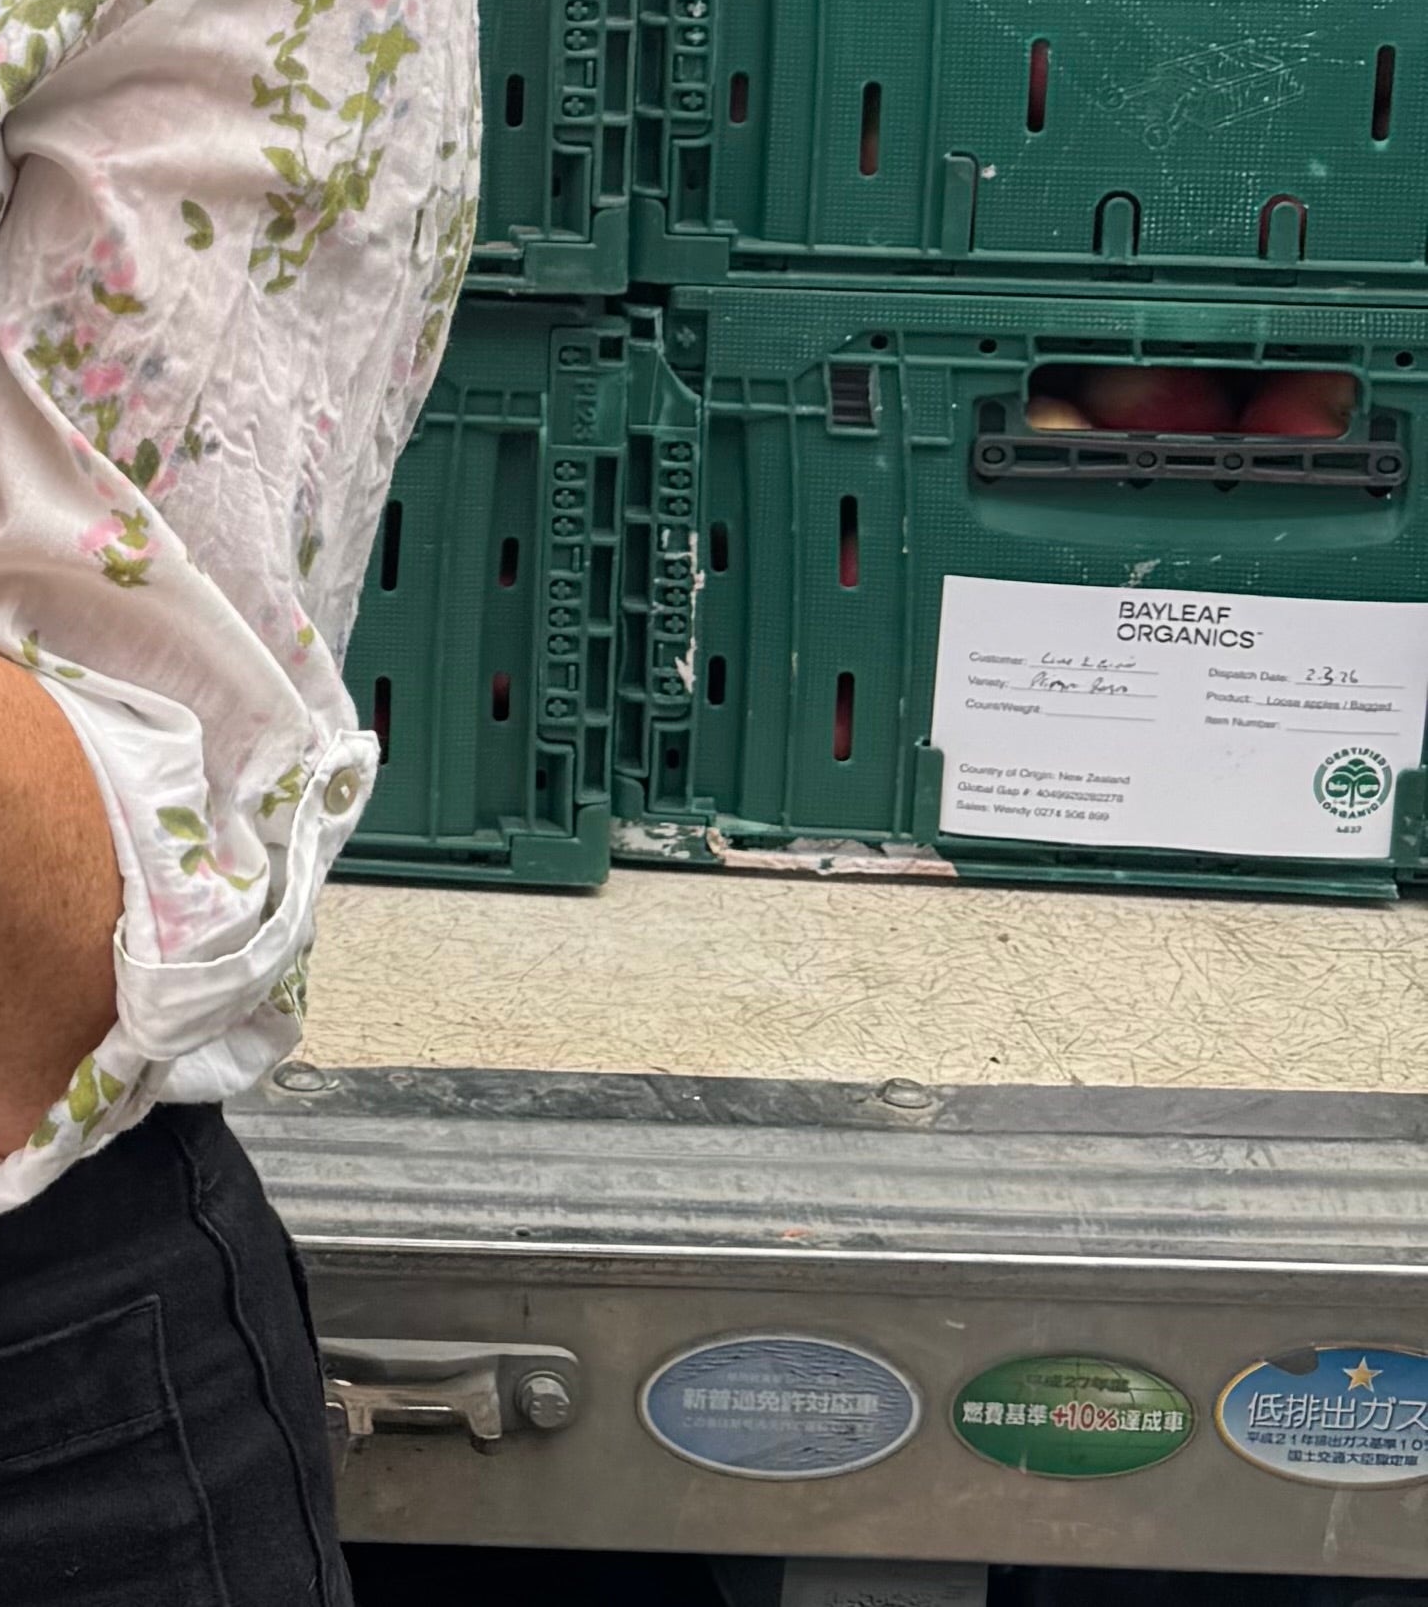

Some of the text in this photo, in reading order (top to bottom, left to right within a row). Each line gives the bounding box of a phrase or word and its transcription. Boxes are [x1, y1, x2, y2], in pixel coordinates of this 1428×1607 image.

[1118, 600, 1232, 625] BAYLEAF
[959, 763, 1004, 778] Country
[1005, 768, 1017, 778] of
[1058, 771, 1084, 782] New
[1086, 773, 1131, 785] Zealand
[993, 803, 1031, 818] Wendy
